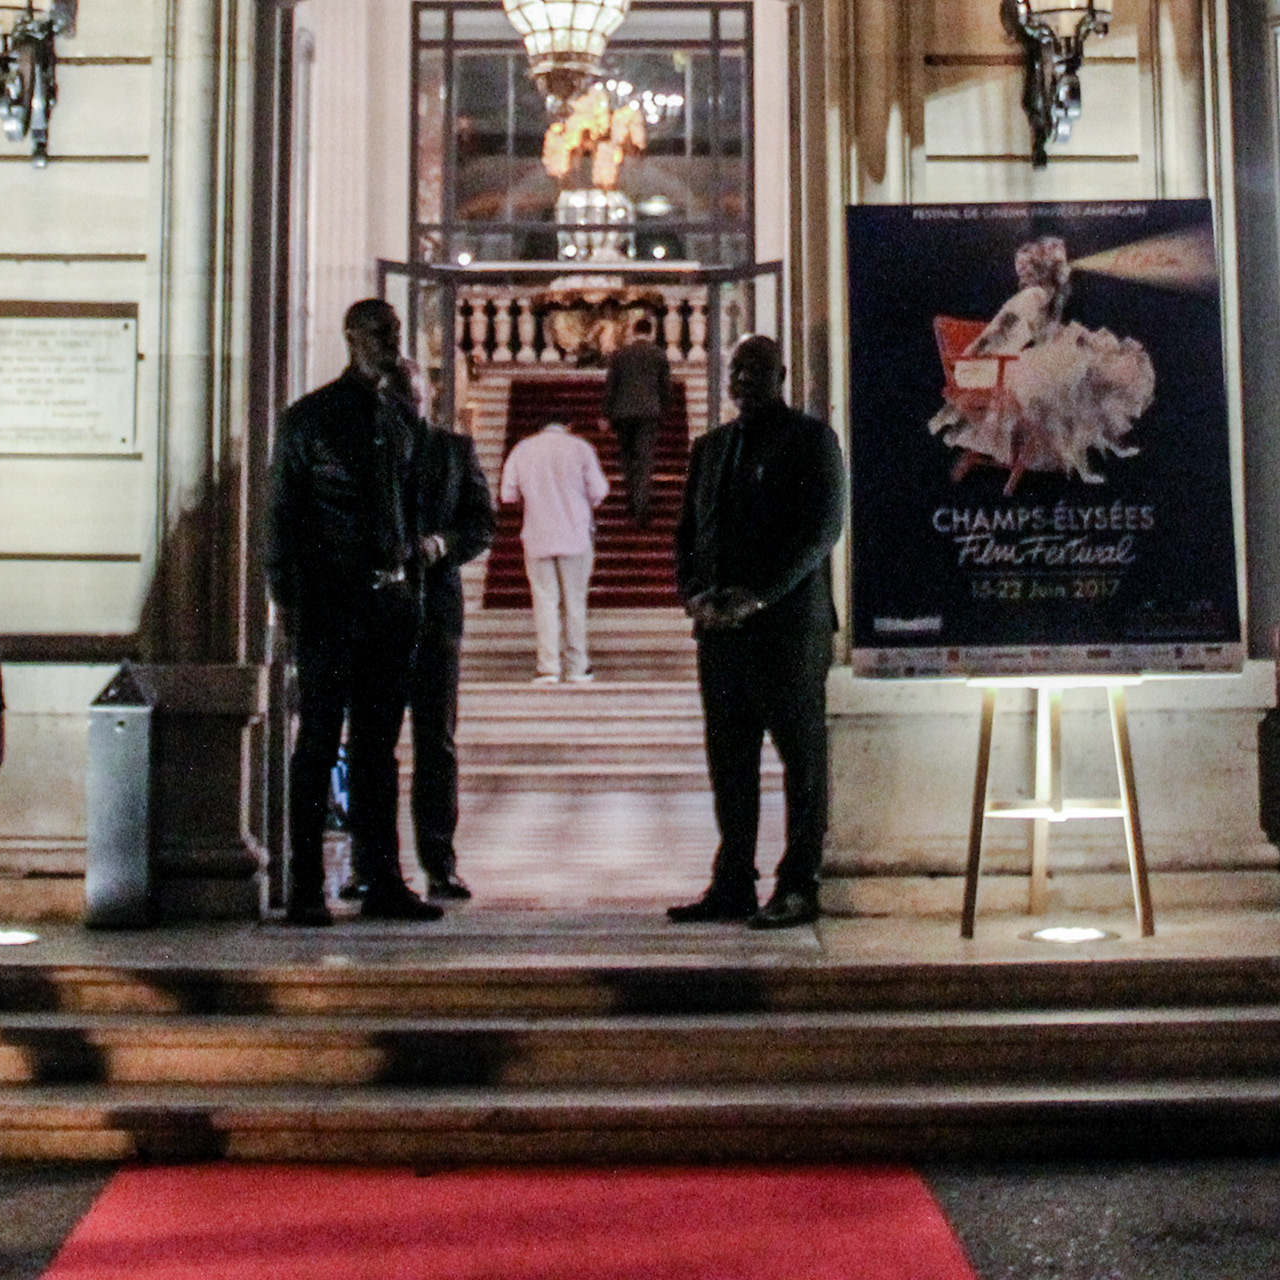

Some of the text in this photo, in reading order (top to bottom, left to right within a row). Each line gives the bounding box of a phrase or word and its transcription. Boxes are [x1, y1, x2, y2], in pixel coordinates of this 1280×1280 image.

[953, 533, 1136, 566] Film Festival
[1073, 579, 1120, 598] 2017
